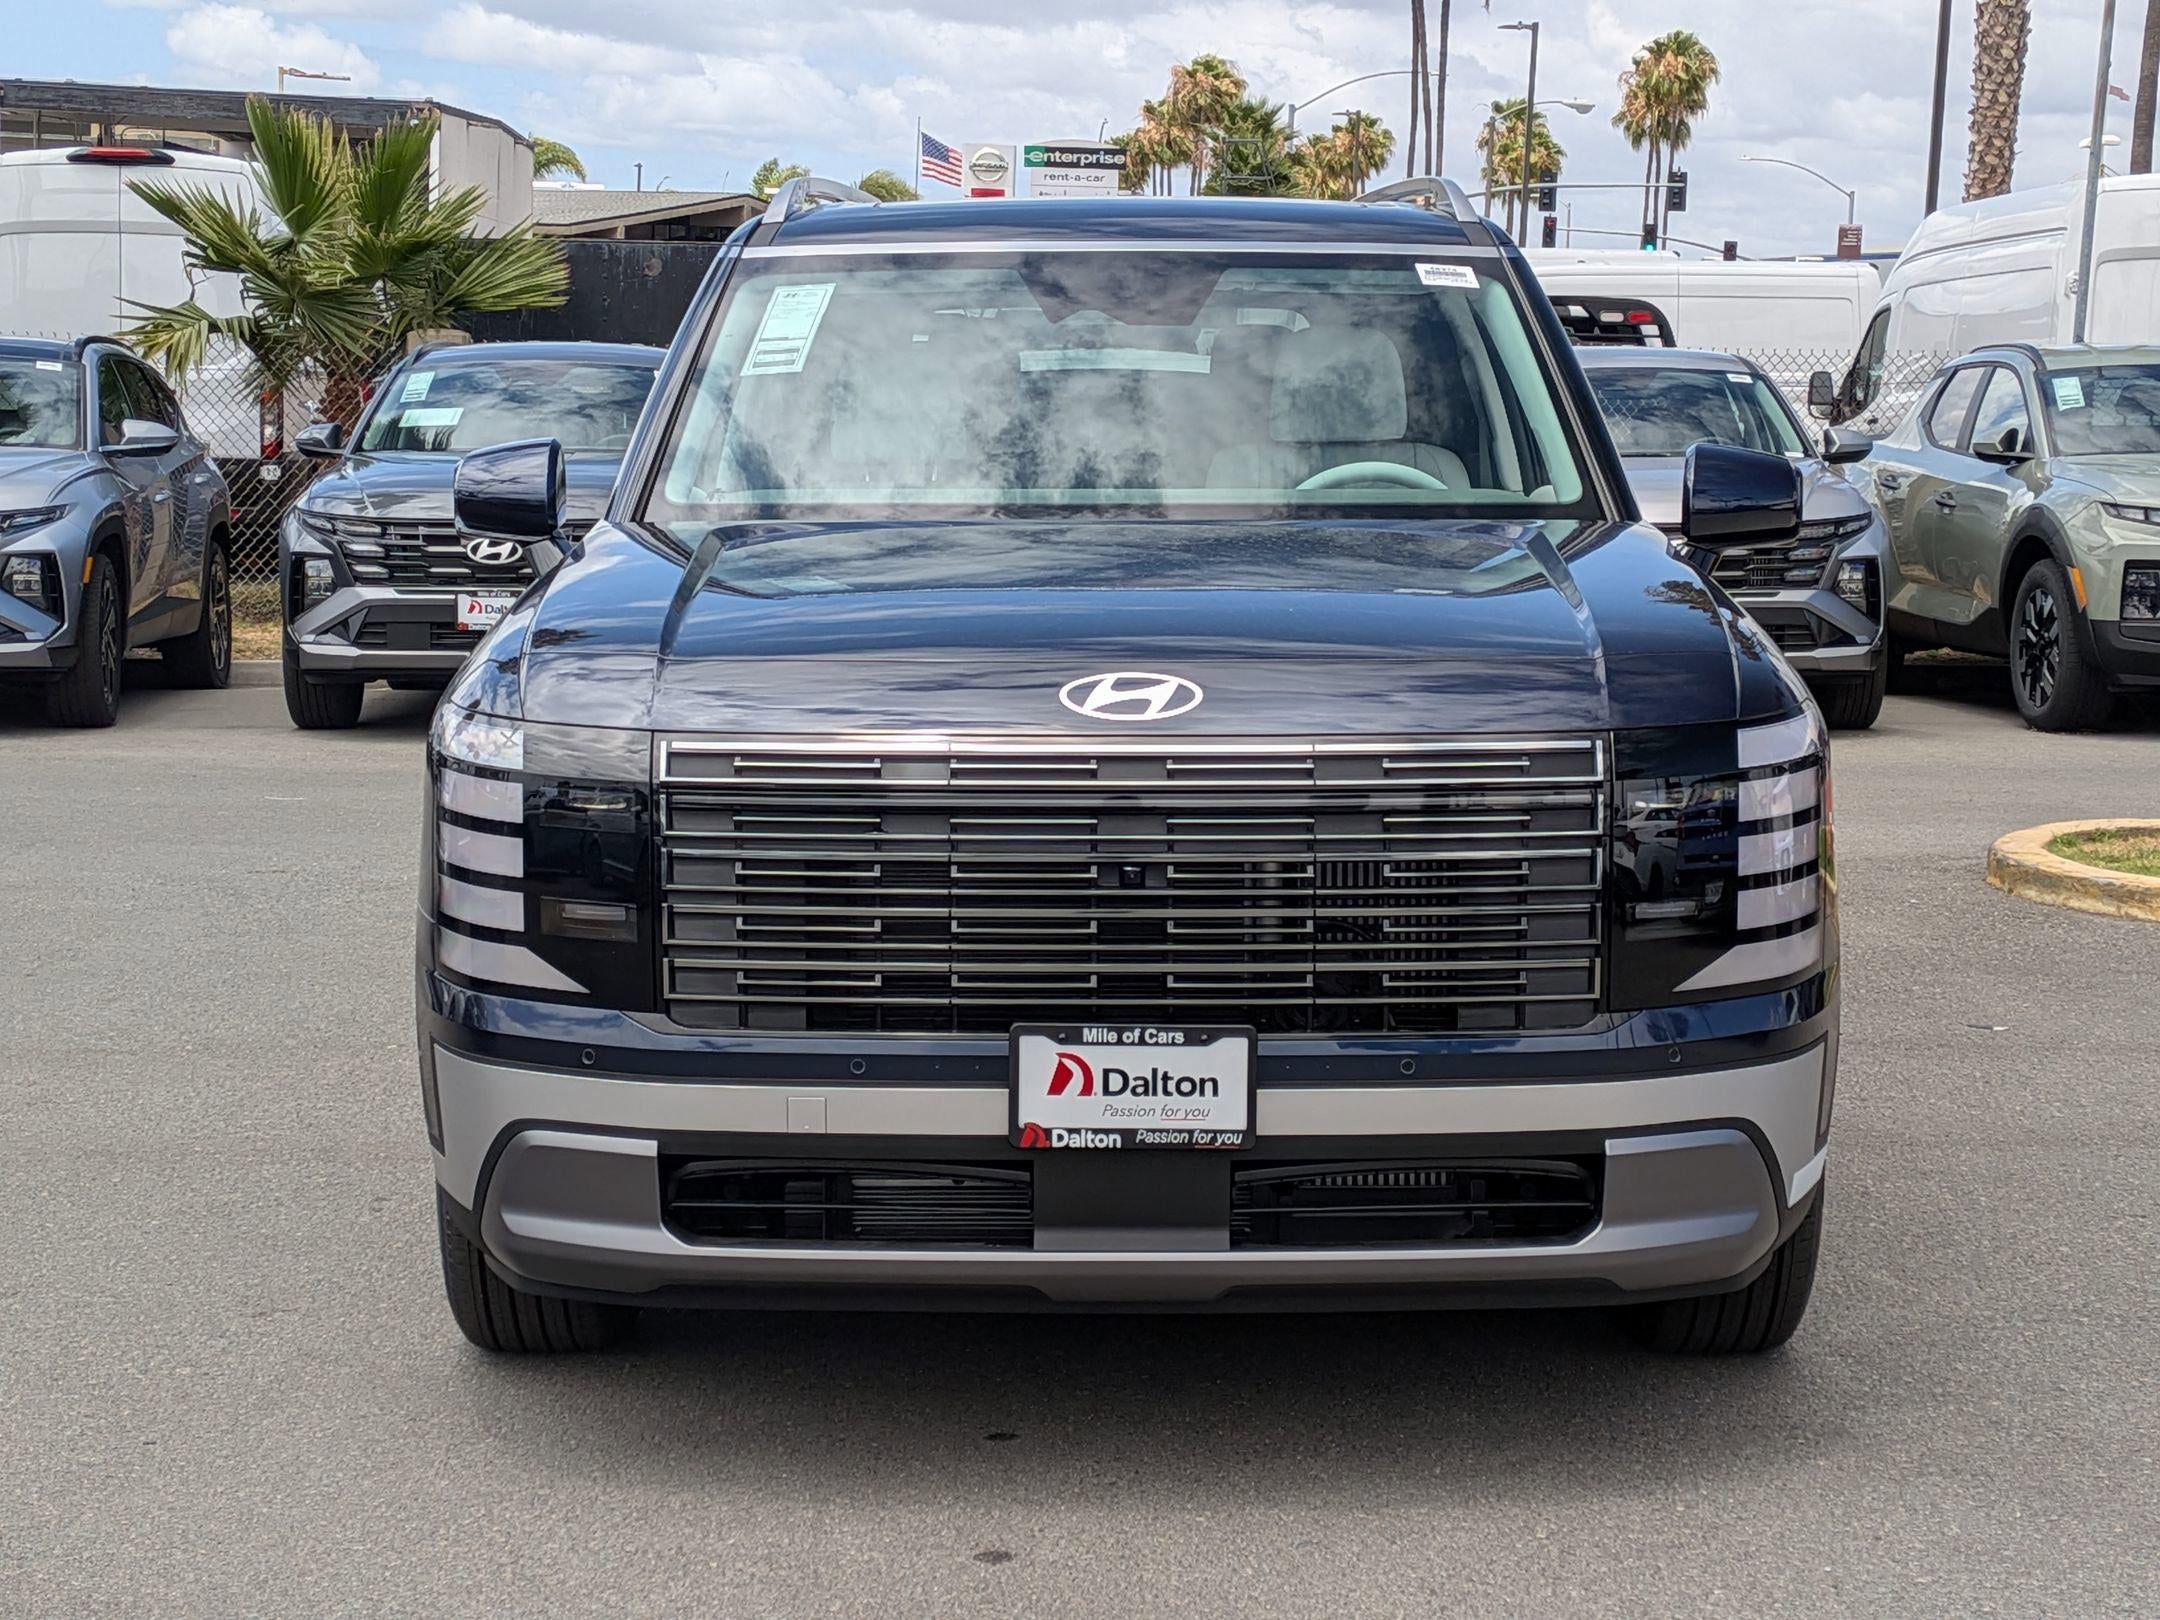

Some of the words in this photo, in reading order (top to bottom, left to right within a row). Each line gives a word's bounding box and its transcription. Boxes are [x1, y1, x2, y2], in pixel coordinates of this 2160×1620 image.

[1029, 150, 1125, 166] enterprise
[1043, 173, 1106, 182] rent-a-car
[485, 604, 509, 615] Dal
[1083, 1028, 1118, 1044] Mile
[1122, 1028, 1141, 1044] of
[1144, 1029, 1185, 1044] Cars
[1102, 1067, 1219, 1098] Dalton
[1102, 1104, 1156, 1118] Passion
[1160, 1104, 1180, 1118] for
[1183, 1107, 1211, 1119] you
[1051, 1128, 1122, 1149] Dalton
[1135, 1129, 1189, 1145] Passion
[1192, 1130, 1214, 1145] for
[1215, 1132, 1243, 1146] you
